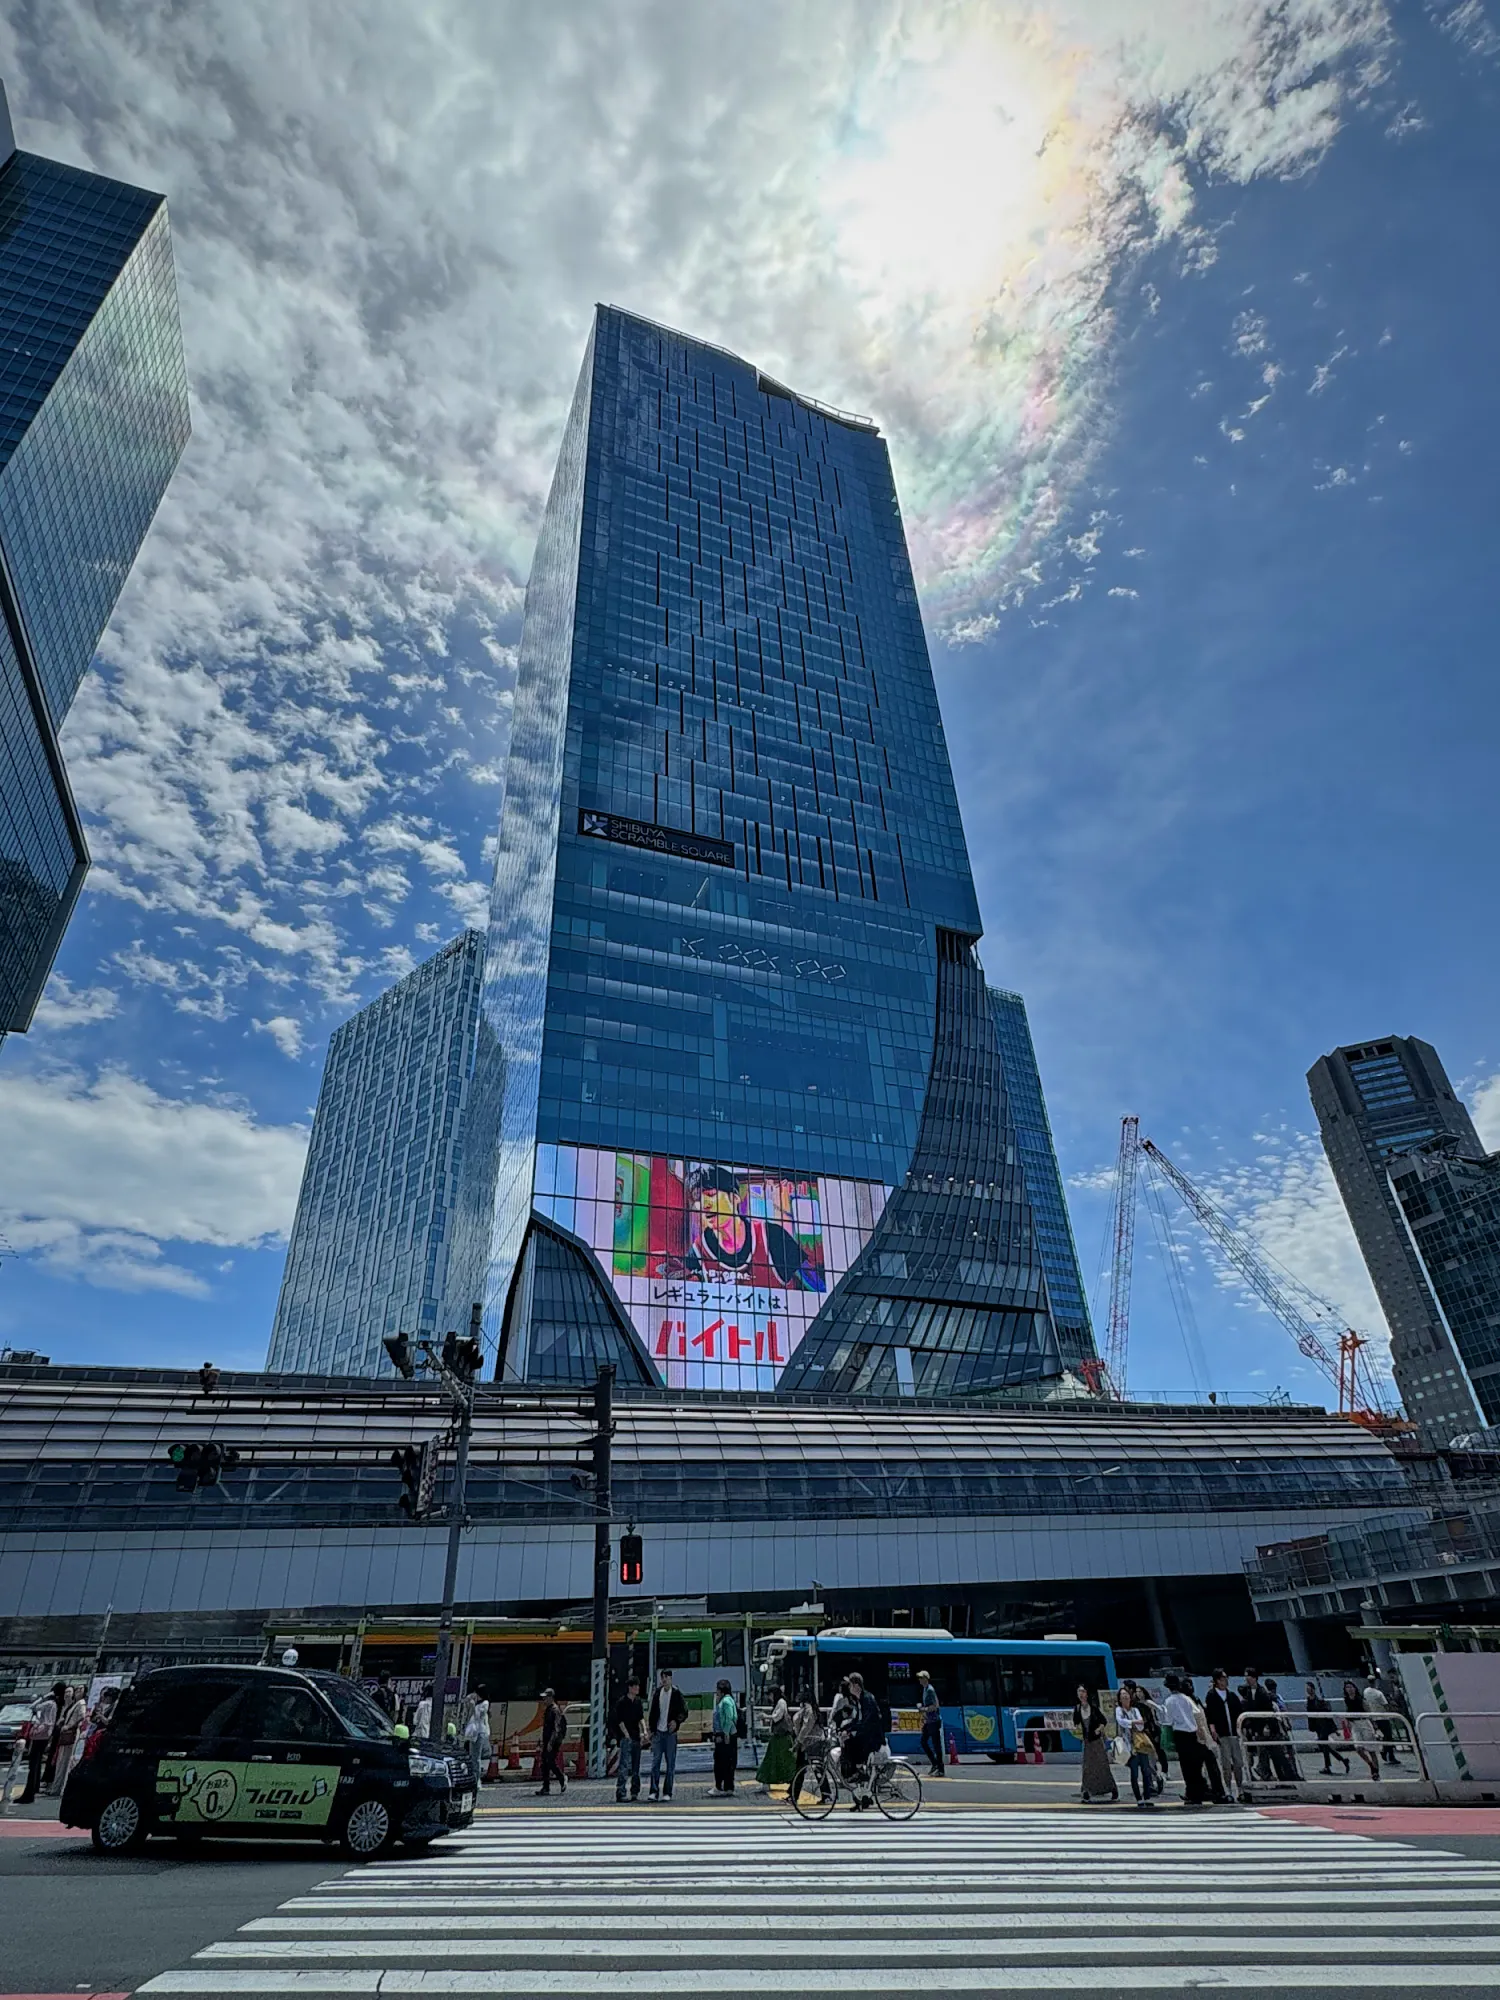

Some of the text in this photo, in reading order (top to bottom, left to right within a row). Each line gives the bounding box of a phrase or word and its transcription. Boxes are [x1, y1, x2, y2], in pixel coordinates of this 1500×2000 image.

[611, 820, 666, 838] SHIBUYA
[610, 829, 731, 863] SCRAMBLE SQUARE
[654, 1286, 788, 1310] レギュラーバイトは、
[655, 1317, 785, 1362] バイトル
